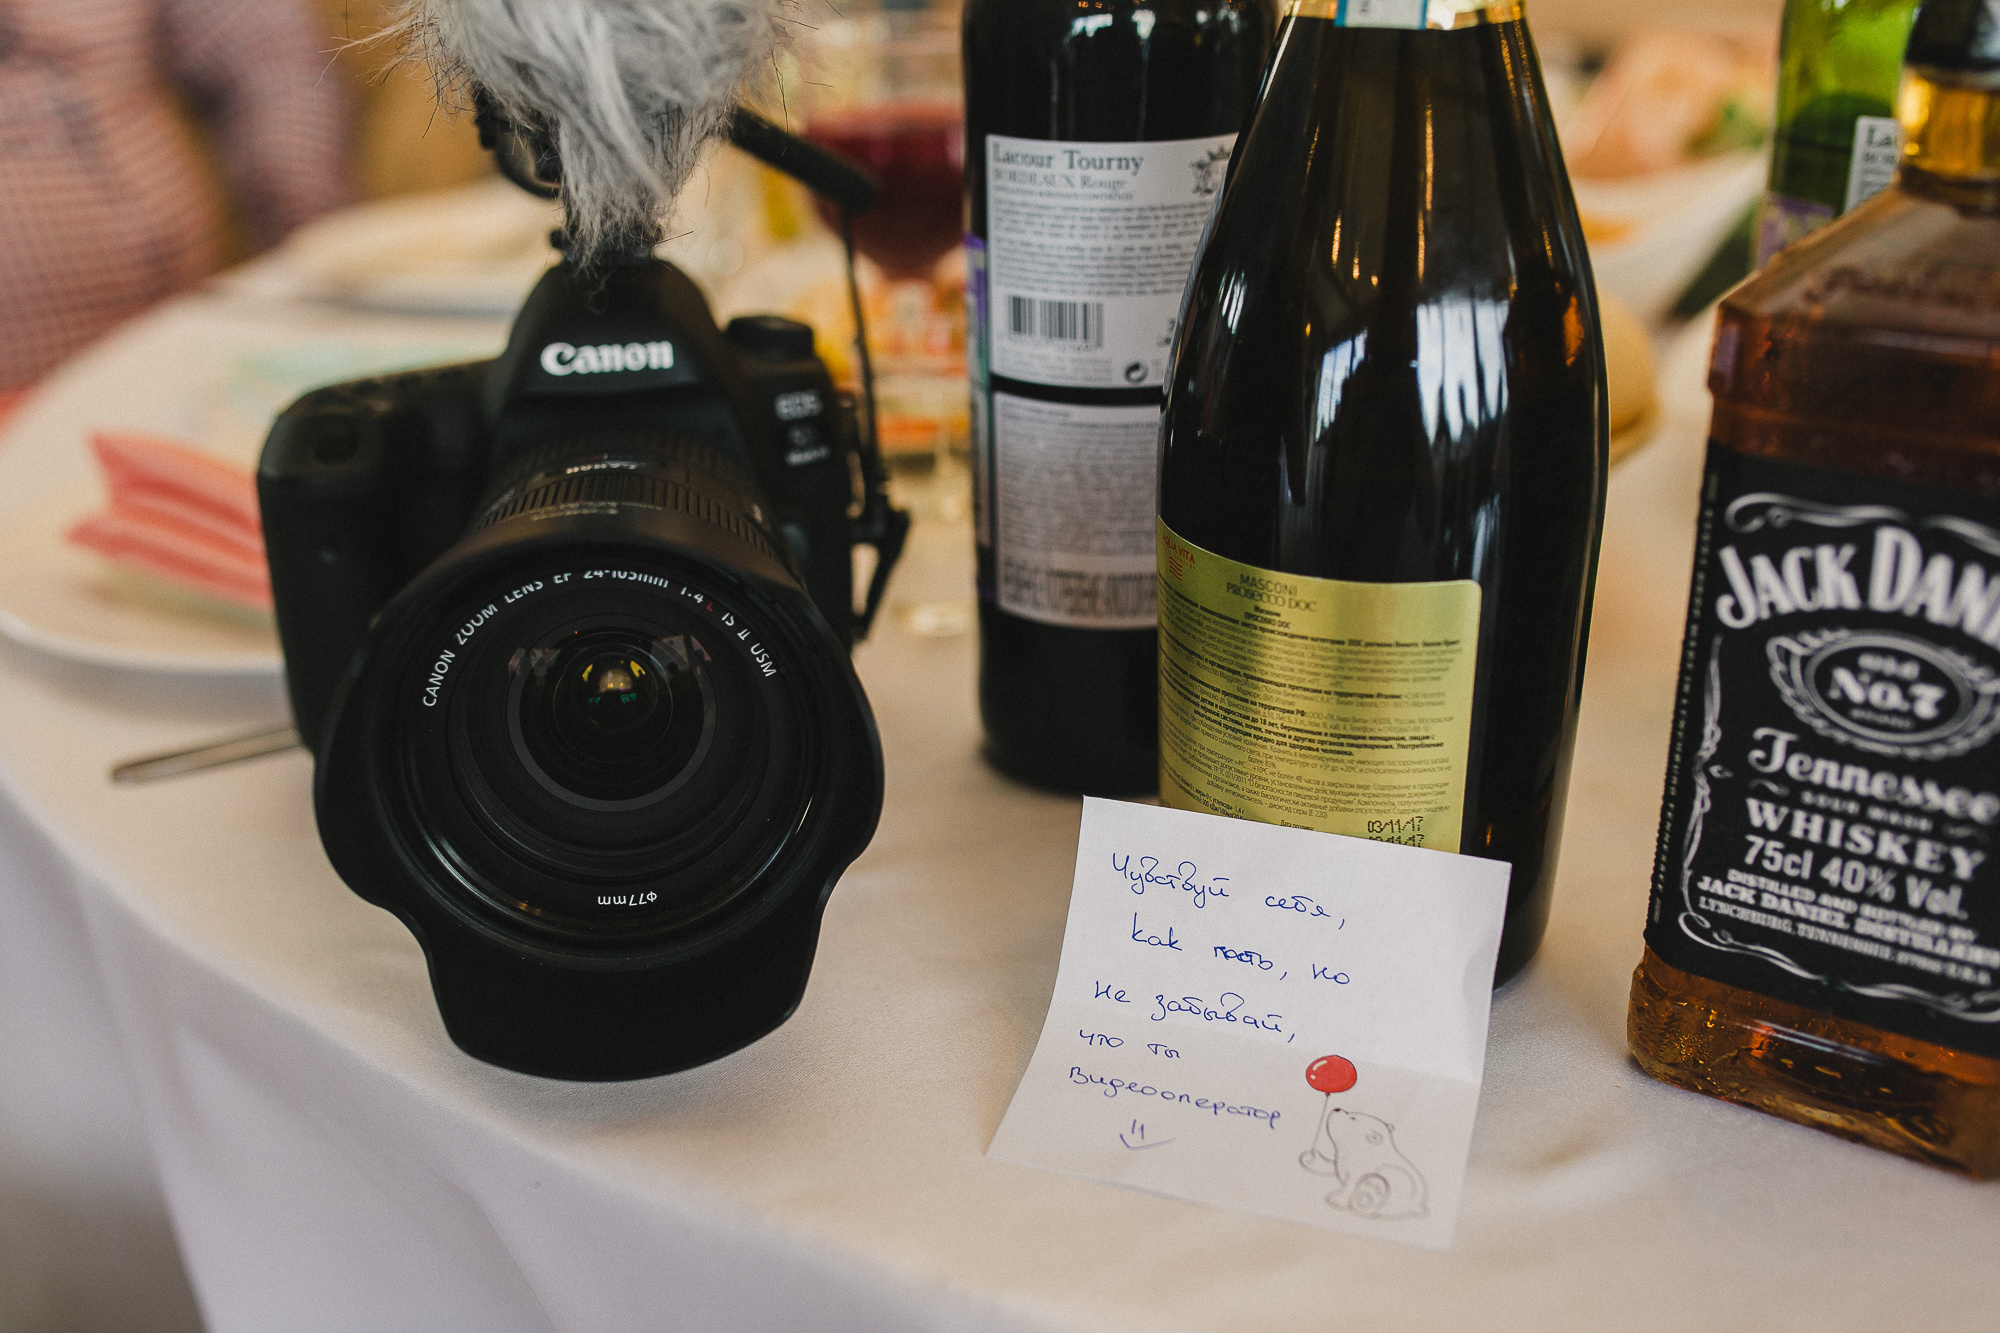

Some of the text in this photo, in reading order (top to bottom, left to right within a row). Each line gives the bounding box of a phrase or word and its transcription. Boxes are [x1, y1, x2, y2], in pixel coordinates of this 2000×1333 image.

[1063, 149, 1144, 176] Tourny
[540, 340, 674, 377] Canon
[1178, 545, 1196, 565] VITA
[1240, 573, 1298, 597] MASCONI
[1716, 543, 1862, 630] JACK
[1288, 597, 1317, 613] DOC
[422, 649, 456, 707] CANON
[455, 604, 499, 646] ZOOM
[750, 642, 778, 678] USM
[1218, 705, 1250, 721] подросткам
[1250, 715, 1259, 724] до
[1259, 717, 1267, 725] 18
[1267, 720, 1279, 729] лет,
[1220, 714, 1244, 728] системы,
[1244, 723, 1264, 733] почек,
[1252, 733, 1275, 745] вредно
[1275, 739, 1287, 747] для
[1224, 769, 1247, 784] 021/2011
[1748, 727, 2000, 824] Tennessee
[1279, 819, 1292, 828] Дата
[1367, 816, 1424, 834] 03/11/17
[1746, 797, 1987, 881] WHISKEY
[1112, 852, 1346, 930] Чувствуй себя,
[1744, 834, 1969, 921] 75cl 40% Vol.
[1697, 875, 1757, 905] JACK
[1761, 893, 1851, 931] DANIEL
[1312, 962, 1351, 986] но
[1150, 992, 1296, 1044] забывай,
[1079, 1028, 1181, 1060] что ты
